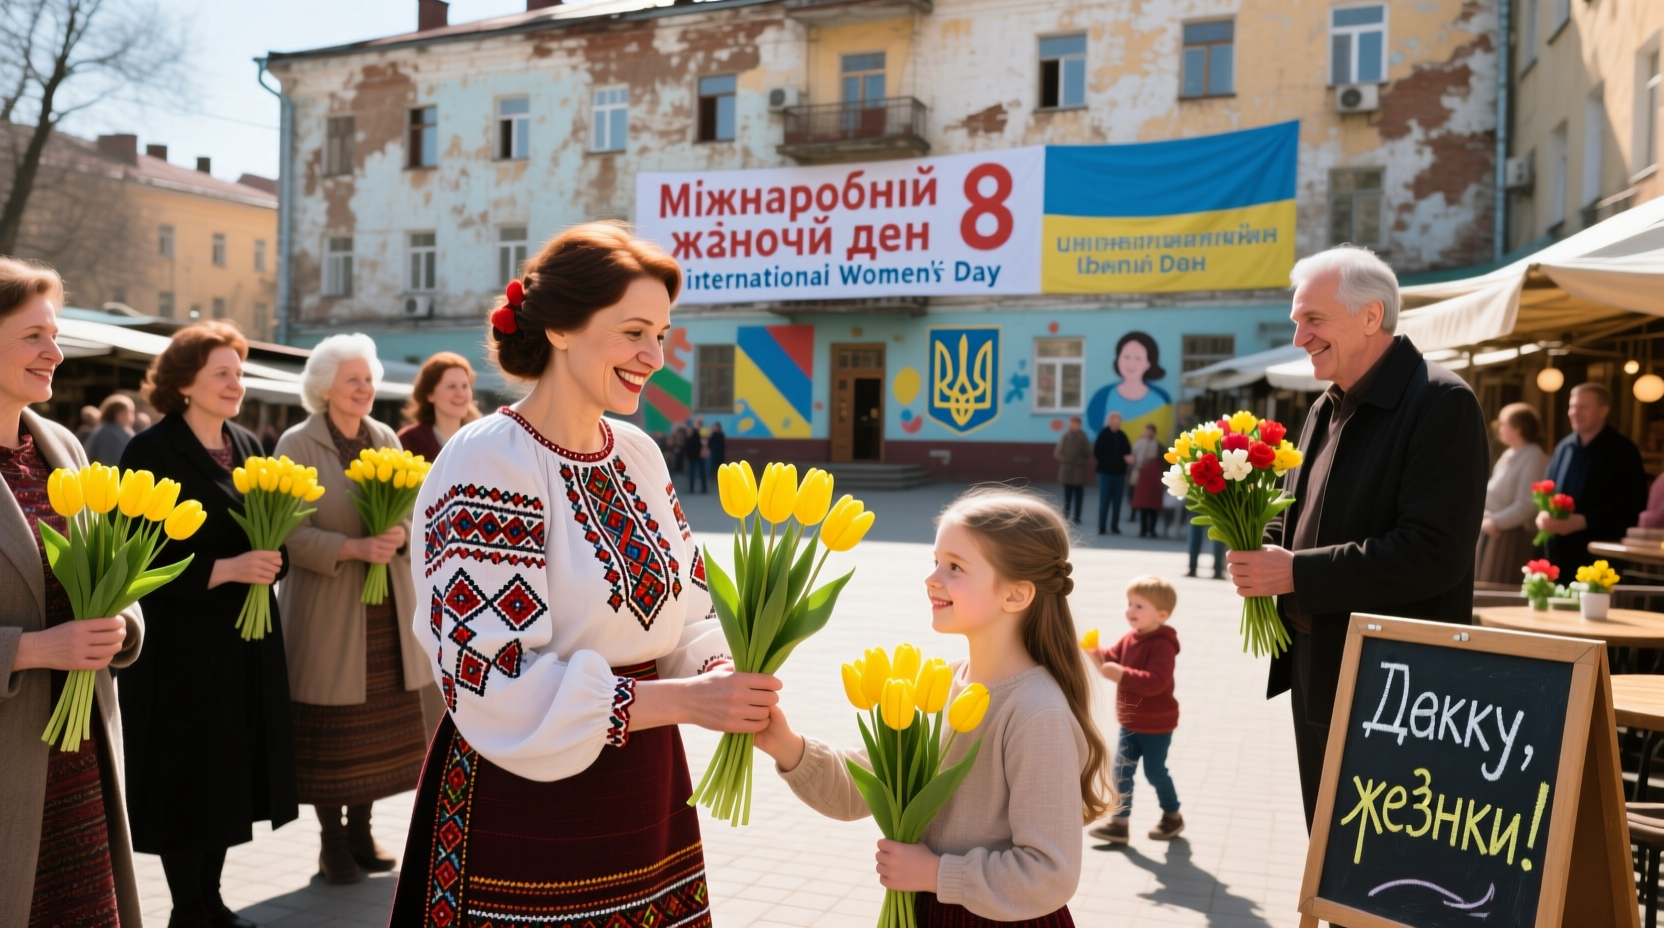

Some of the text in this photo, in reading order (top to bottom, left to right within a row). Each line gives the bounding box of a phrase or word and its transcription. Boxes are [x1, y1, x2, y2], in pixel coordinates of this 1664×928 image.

[960, 162, 1014, 251] 8
[846, 222, 930, 261] ден
[954, 261, 1002, 287] Day
